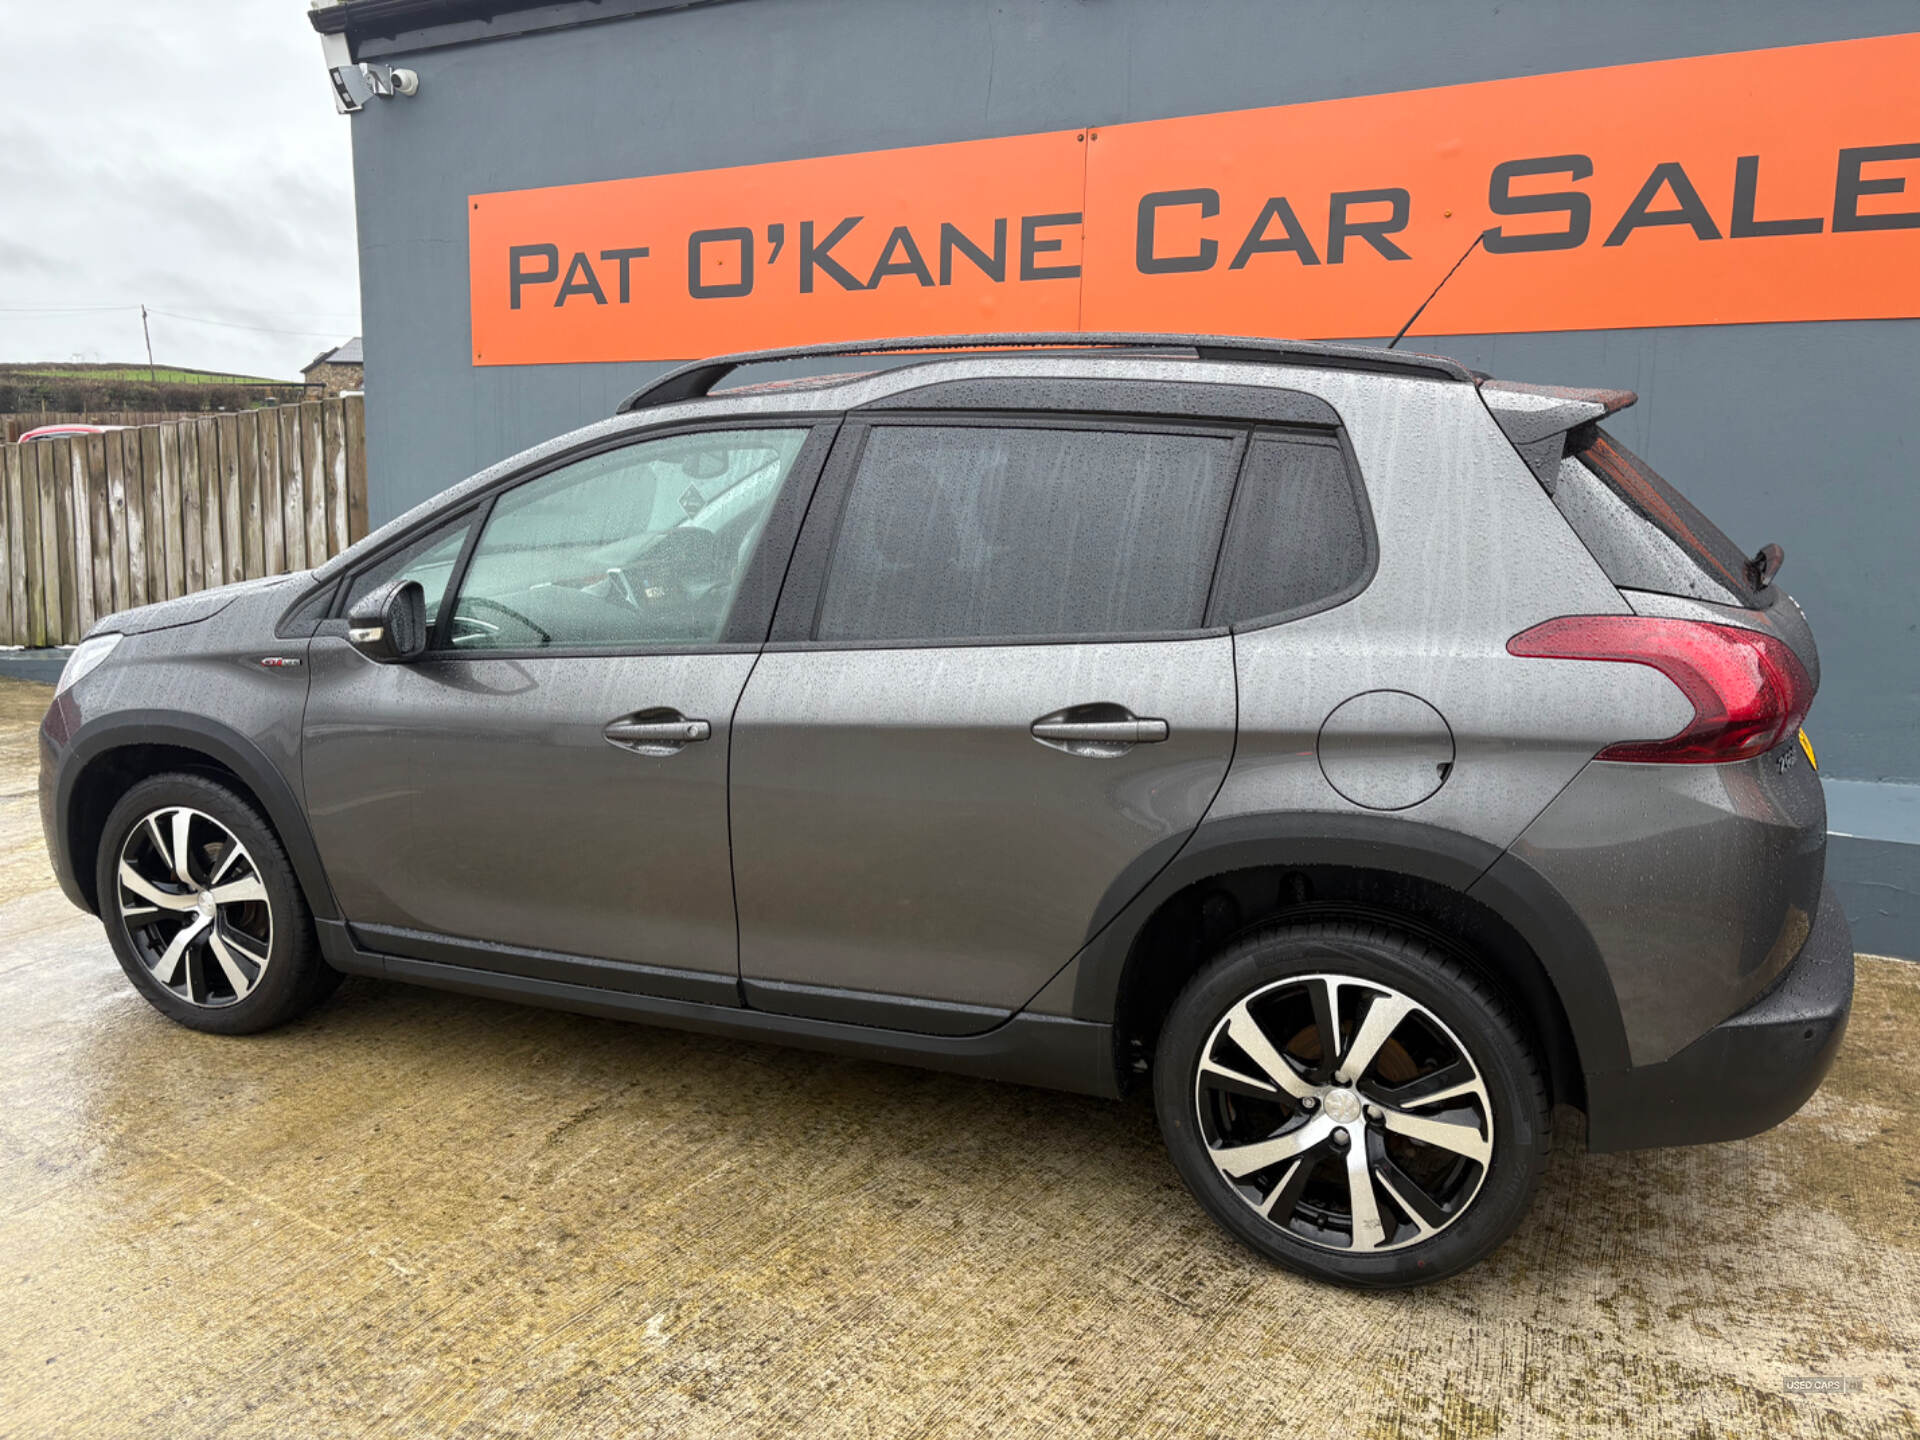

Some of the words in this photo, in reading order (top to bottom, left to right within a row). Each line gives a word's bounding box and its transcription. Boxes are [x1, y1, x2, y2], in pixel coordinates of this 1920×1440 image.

[511, 243, 649, 309] PAT
[688, 212, 1083, 299] O'KANE
[1136, 188, 1411, 275] CAR
